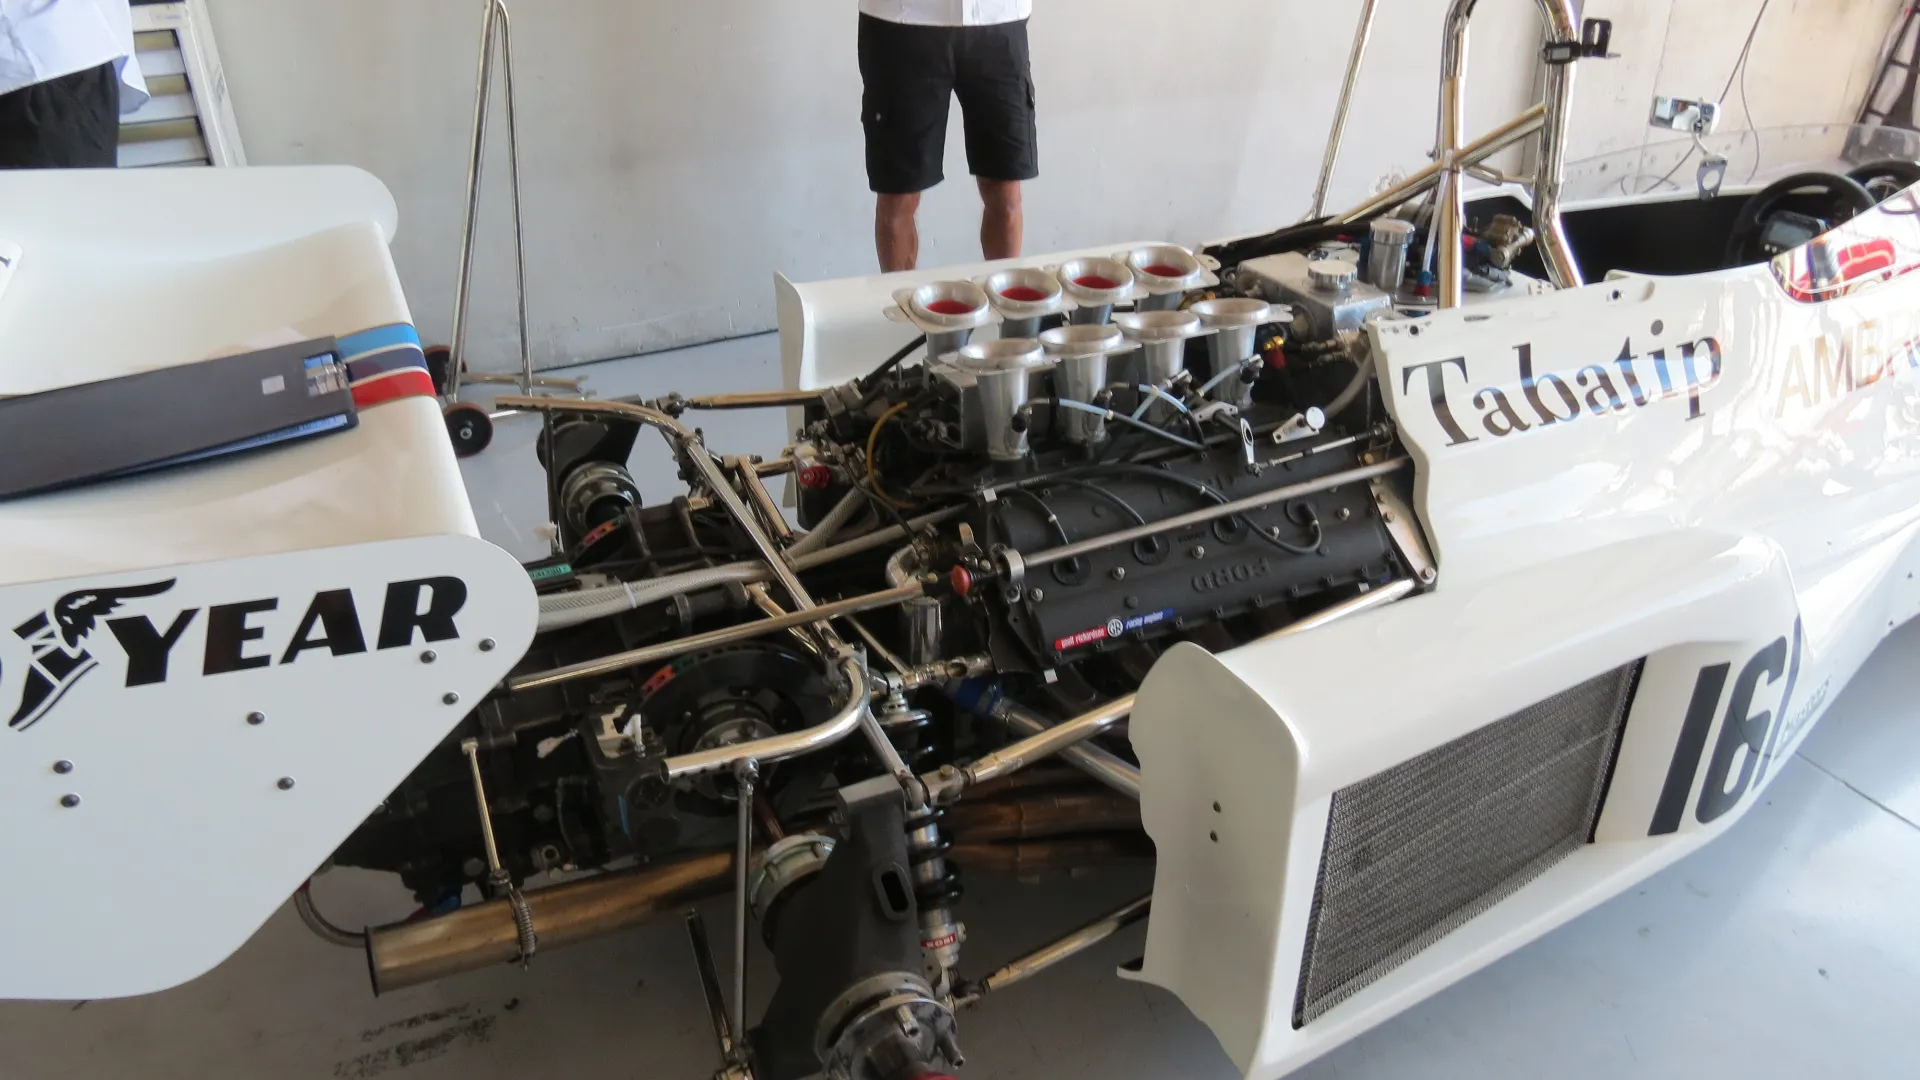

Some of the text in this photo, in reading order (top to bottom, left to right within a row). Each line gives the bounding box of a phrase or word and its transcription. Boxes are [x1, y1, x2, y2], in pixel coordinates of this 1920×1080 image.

[1402, 319, 1722, 447] Tabatip
[1774, 313, 1920, 419] AMBR
[105, 576, 468, 688] YEAR
